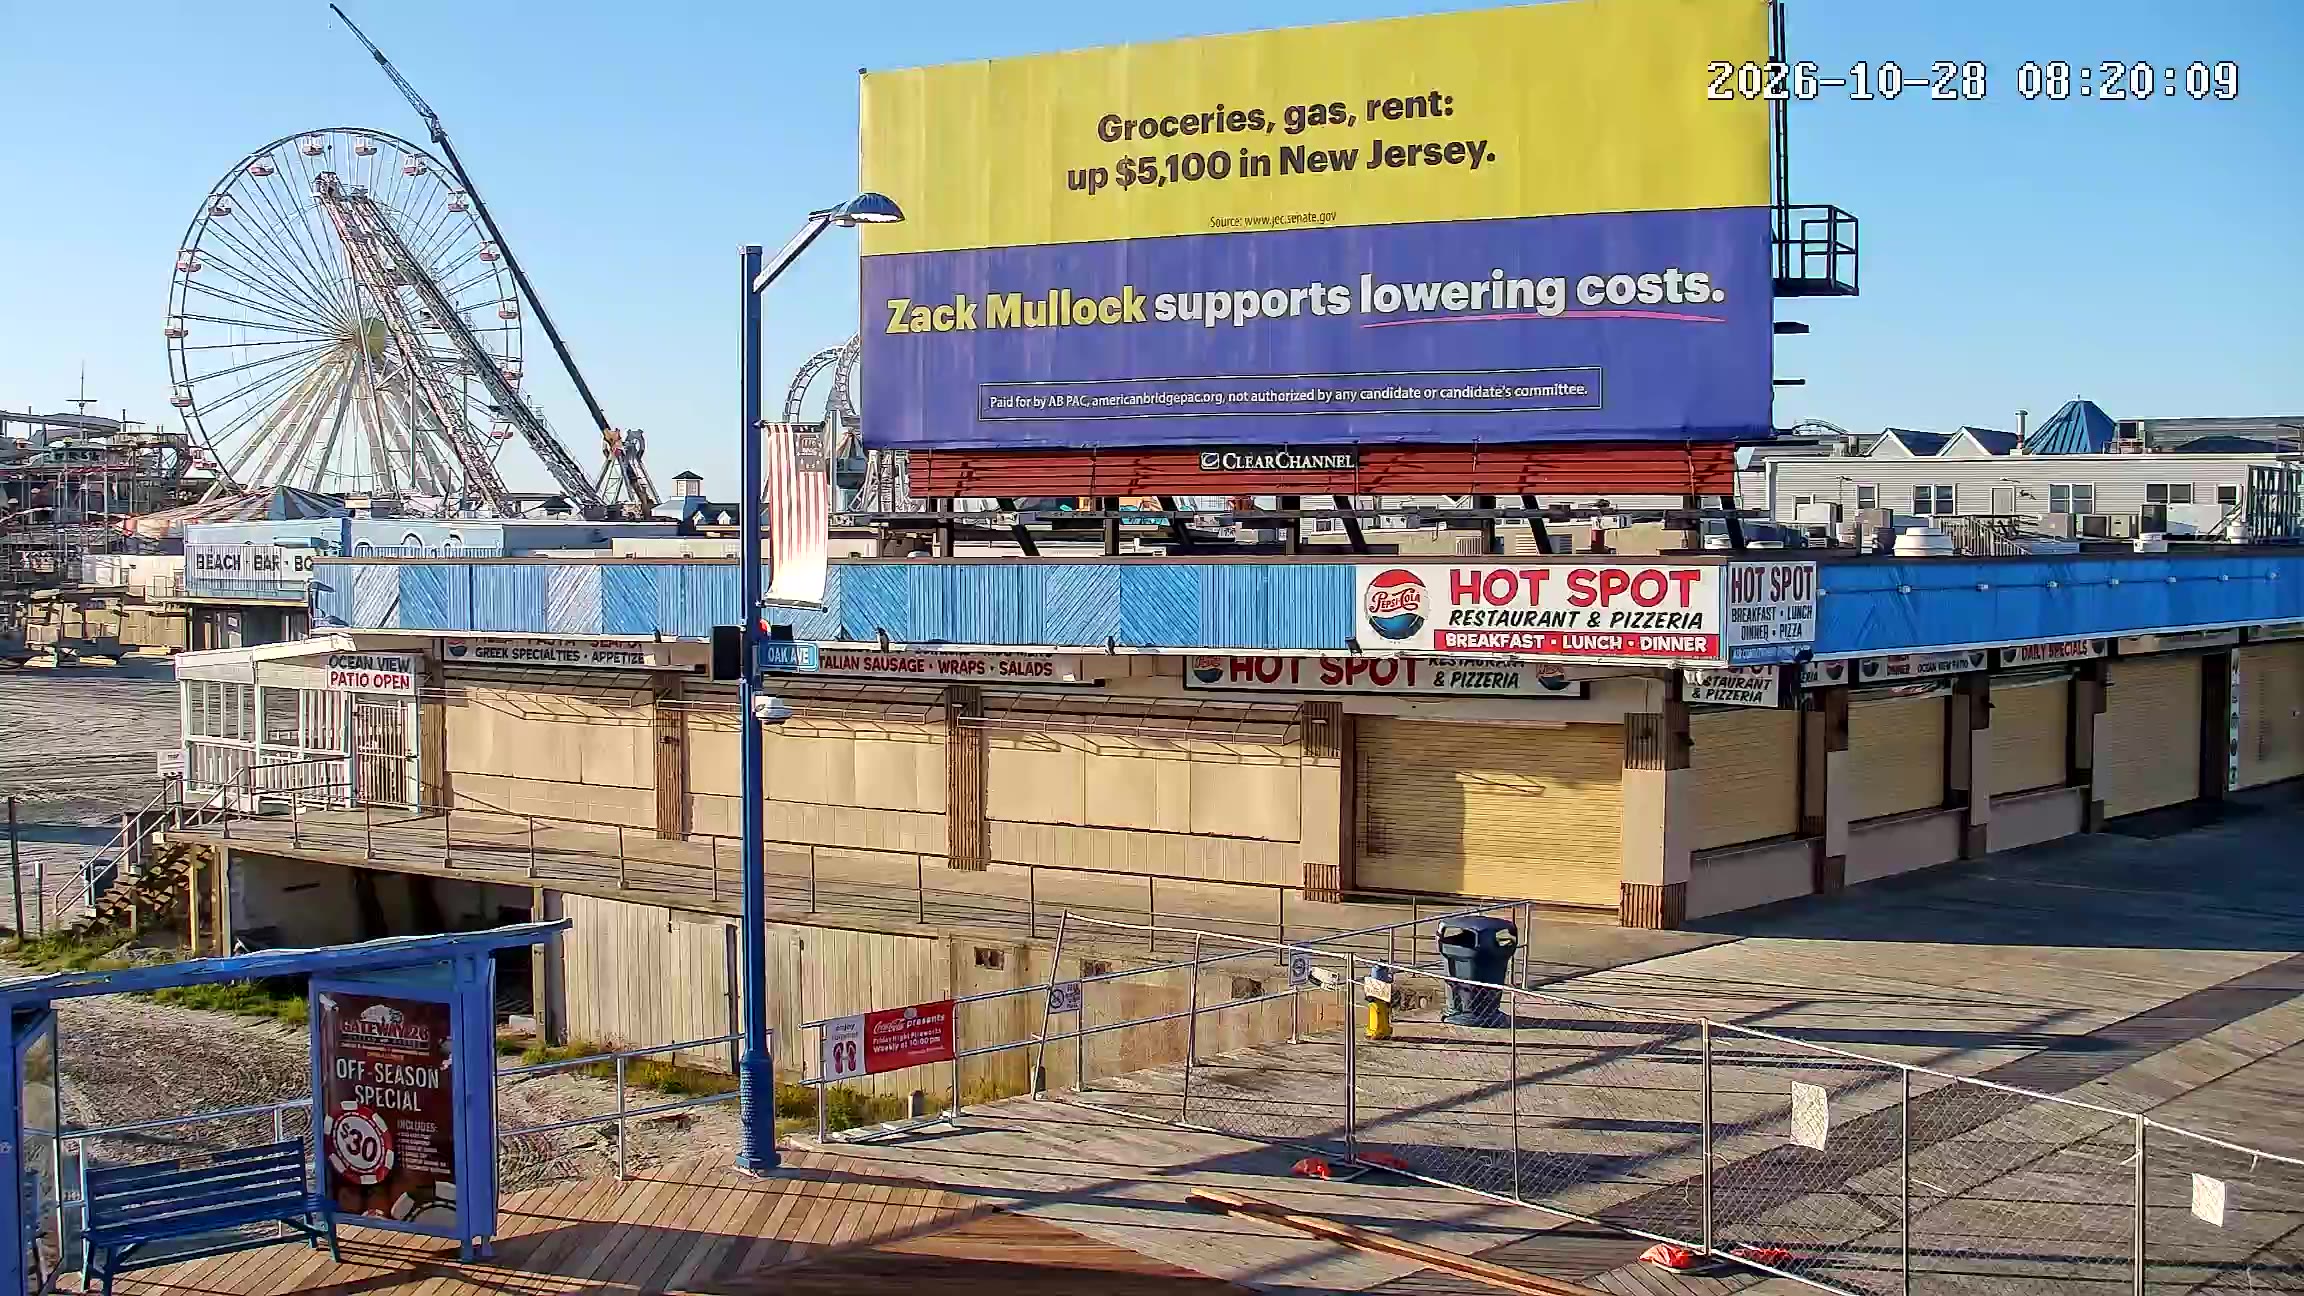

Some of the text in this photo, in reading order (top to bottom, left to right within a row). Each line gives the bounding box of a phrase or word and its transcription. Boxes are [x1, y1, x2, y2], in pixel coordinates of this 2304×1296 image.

[1097, 90, 1454, 142] Groceries, gas, rent:
[1067, 138, 1497, 195] up $5,100 in New Jersey.
[1209, 211, 1337, 228] Source: www.jec.senate.gov
[886, 267, 1725, 334] Zack Mullock supports lowering costs.
[990, 383, 1588, 410] Paid for by AB PAC, americanbridgepac.org, not authorized by any candidate or candidate's committee.
[196, 554, 241, 571] BEACH
[254, 554, 280, 571] BAR
[1449, 568, 1701, 608] HOT SPOT
[1732, 566, 1813, 603] HOT SPOT
[1448, 610, 1703, 630] RESTAURANT & PIZZERIA
[1732, 605, 1812, 622] BREAKFAST LUNCH
[1741, 623, 1802, 640] DINNER PIZZA
[1446, 632, 1708, 652] BREAKFAST LUNCH DINNER
[328, 654, 411, 672] OCEAN VIEW
[476, 647, 508, 658] GREEK
[512, 648, 580, 662] SPECIALTIES
[768, 647, 808, 664] OAK AVE
[819, 655, 1053, 677] TALIAN SAUSAGE WRAPS SALADS
[1229, 656, 1299, 684] HOT
[1320, 656, 1420, 687] SPOT
[330, 671, 410, 690] PATIO OPEN
[1433, 671, 1520, 689] & PIZZERIA
[1702, 676, 1772, 690] STAURANT
[1706, 689, 1763, 702] PIZZERIA
[906, 1014, 945, 1028] presents
[355, 1084, 421, 1111] SPECIAL
